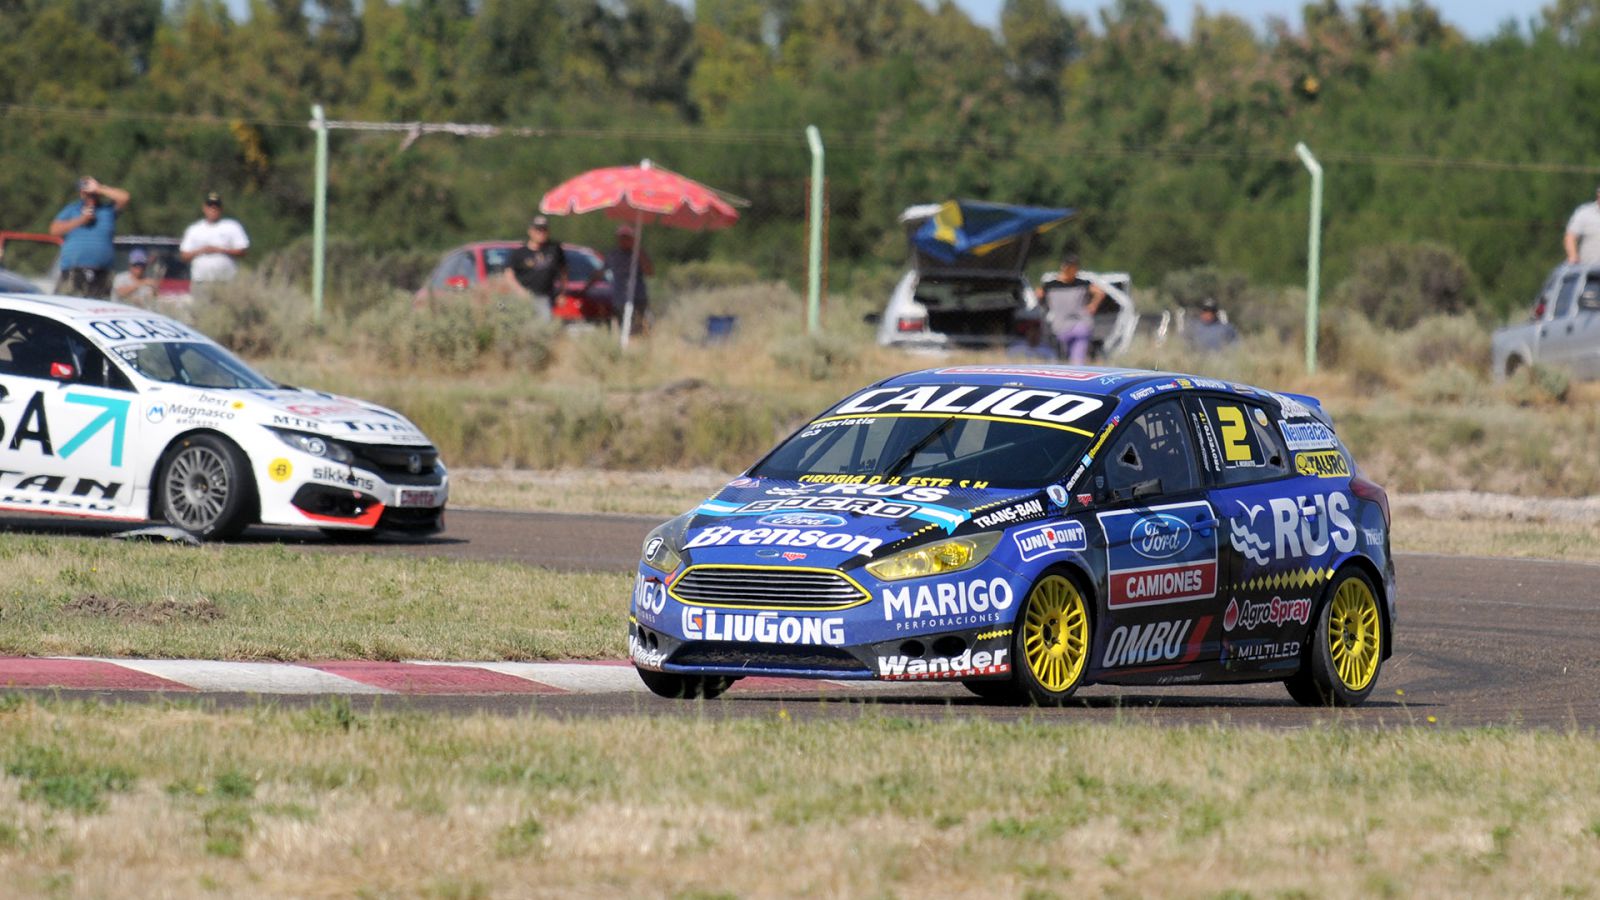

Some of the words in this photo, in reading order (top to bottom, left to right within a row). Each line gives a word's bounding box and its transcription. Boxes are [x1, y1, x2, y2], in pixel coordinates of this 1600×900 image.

[168, 404, 236, 421] Magnasco
[836, 386, 1103, 421] CALICO
[0, 384, 54, 456] A
[274, 415, 319, 430] MTR
[811, 417, 876, 429] moriatis
[1216, 406, 1252, 460] 2
[824, 482, 950, 502] RUS
[867, 476, 902, 486] DL
[905, 477, 953, 487] ESTE
[973, 499, 1043, 528] TRANS-BAN
[1269, 491, 1357, 559] RUS
[682, 526, 883, 557] Brenson
[1142, 521, 1181, 552] Ford
[882, 577, 1013, 621] MARIGO
[1126, 569, 1202, 599] CAMIONES
[896, 612, 1001, 631] PERFORACIONES
[1238, 596, 1312, 630] AgroSpray
[1102, 618, 1192, 668] OMBU
[878, 648, 1007, 676] Wander
